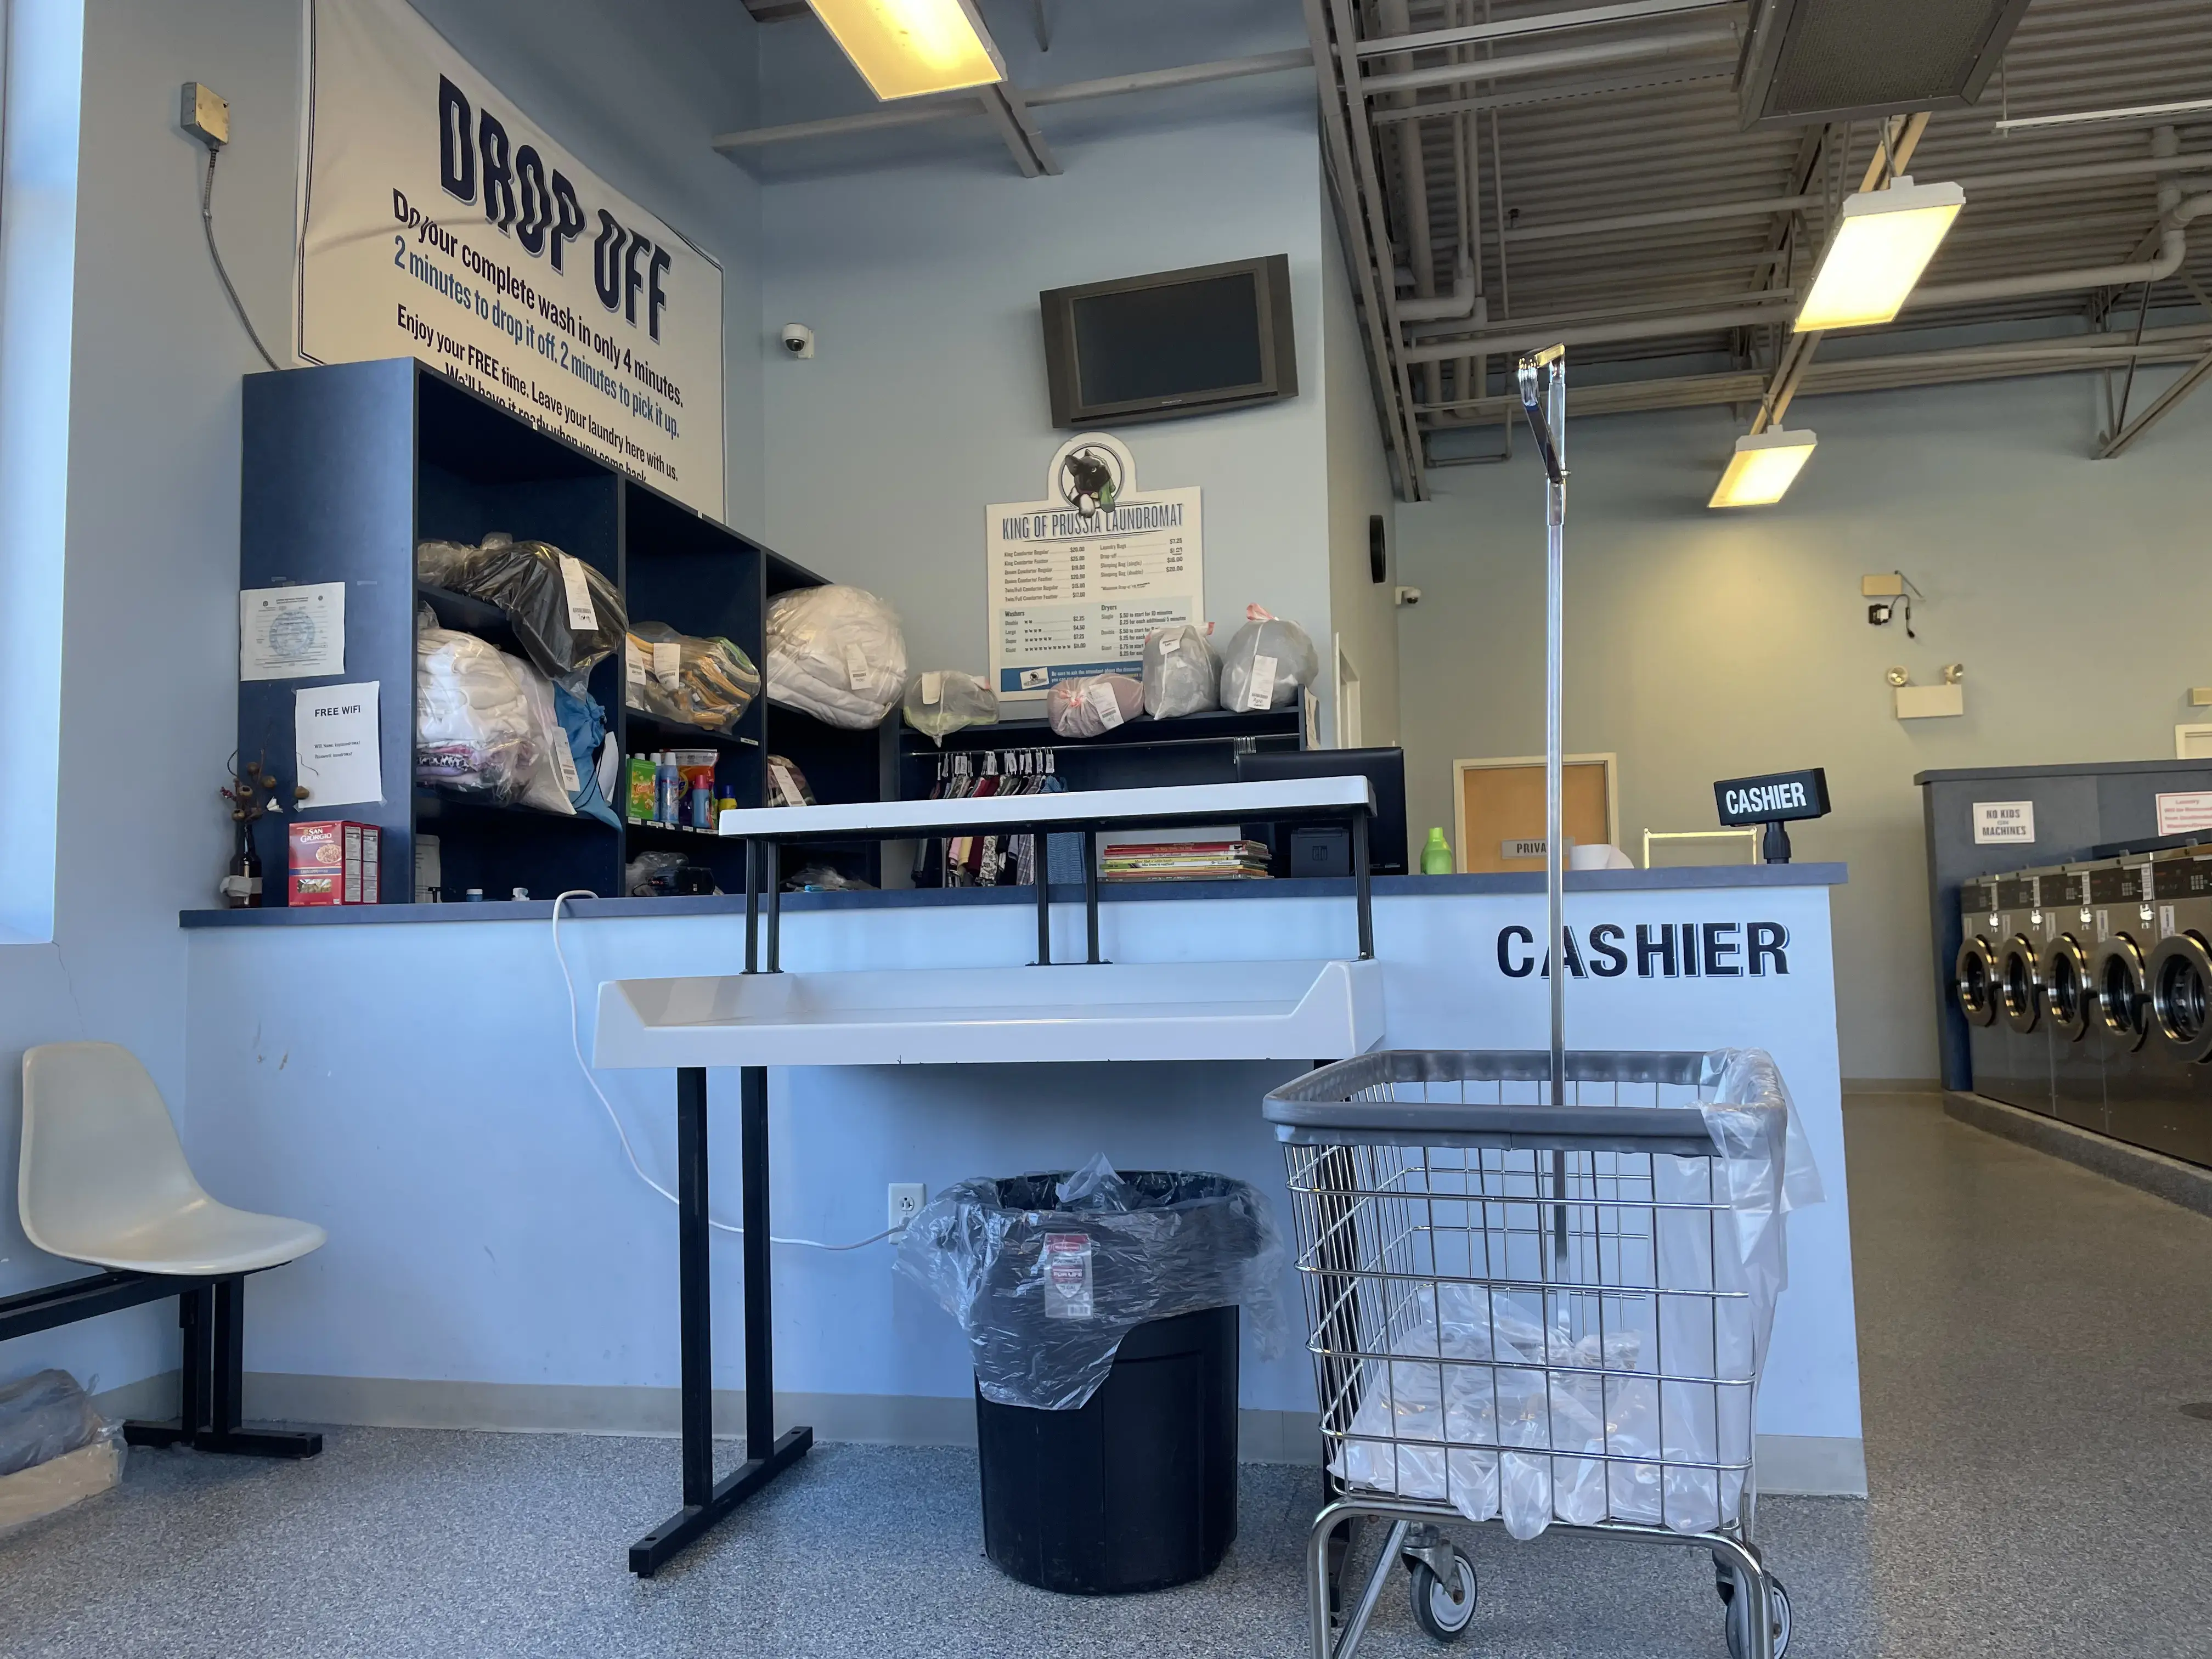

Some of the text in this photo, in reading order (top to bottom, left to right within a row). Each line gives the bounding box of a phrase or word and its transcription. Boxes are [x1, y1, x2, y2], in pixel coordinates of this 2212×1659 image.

[439, 72, 673, 346] DROP OFF
[393, 188, 683, 408] Do your complete wash in only 4 minutes.
[394, 235, 679, 440] 2 minutes to drop it off. 2 minutes to pick it up.
[398, 303, 678, 482] Enjoy your FREE time. Leave your laundry here with us.
[1003, 503, 1183, 540] KING OF PRUSSIA LAUNDROMAT
[314, 704, 360, 717] FREE WIFI
[1726, 782, 1807, 815] CASHIER
[1986, 809, 2021, 819] NO KIDS
[300, 833, 332, 843] GIORGIO
[1516, 843, 1547, 853] PRIVA
[1982, 826, 2026, 836] MACHINES
[1497, 922, 1790, 979] CASHIER
